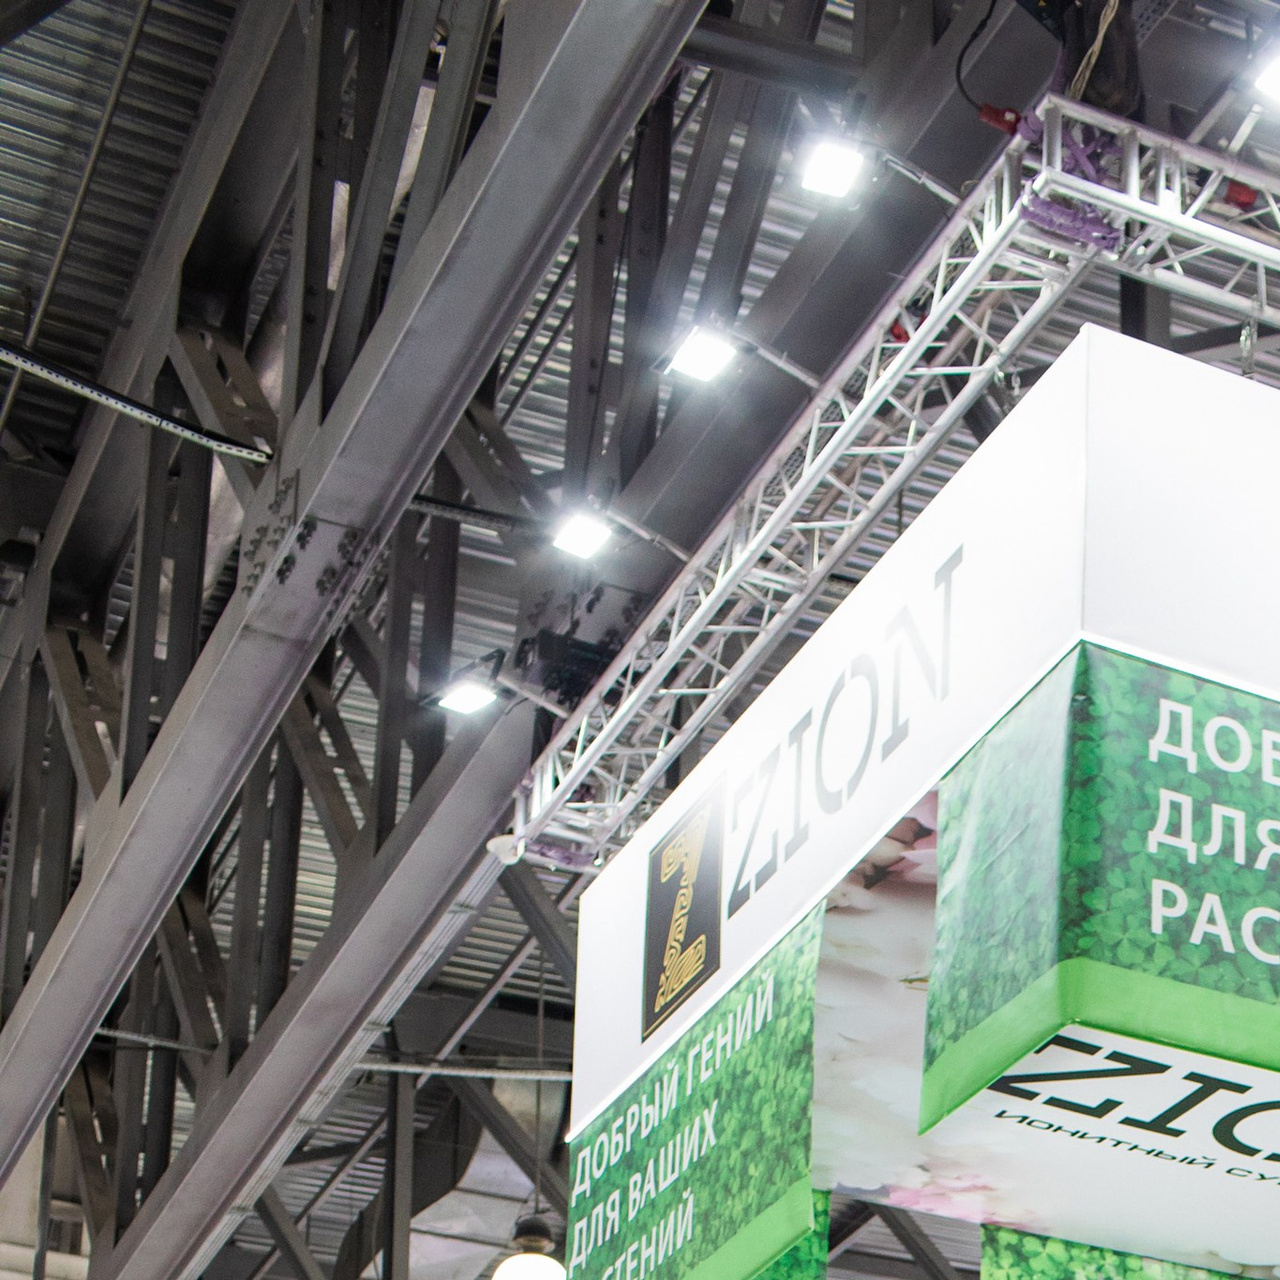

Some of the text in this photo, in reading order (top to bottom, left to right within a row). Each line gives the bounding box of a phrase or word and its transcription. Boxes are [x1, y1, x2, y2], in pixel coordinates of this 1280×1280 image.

[728, 546, 963, 917] ZION
[567, 1100, 719, 1279] ДЛЯ ВАШИХ
[572, 974, 775, 1207] ДОБРЫЙ ГЕНИЙ
[994, 1108, 1216, 1172] ИОНИТНЫЙ
